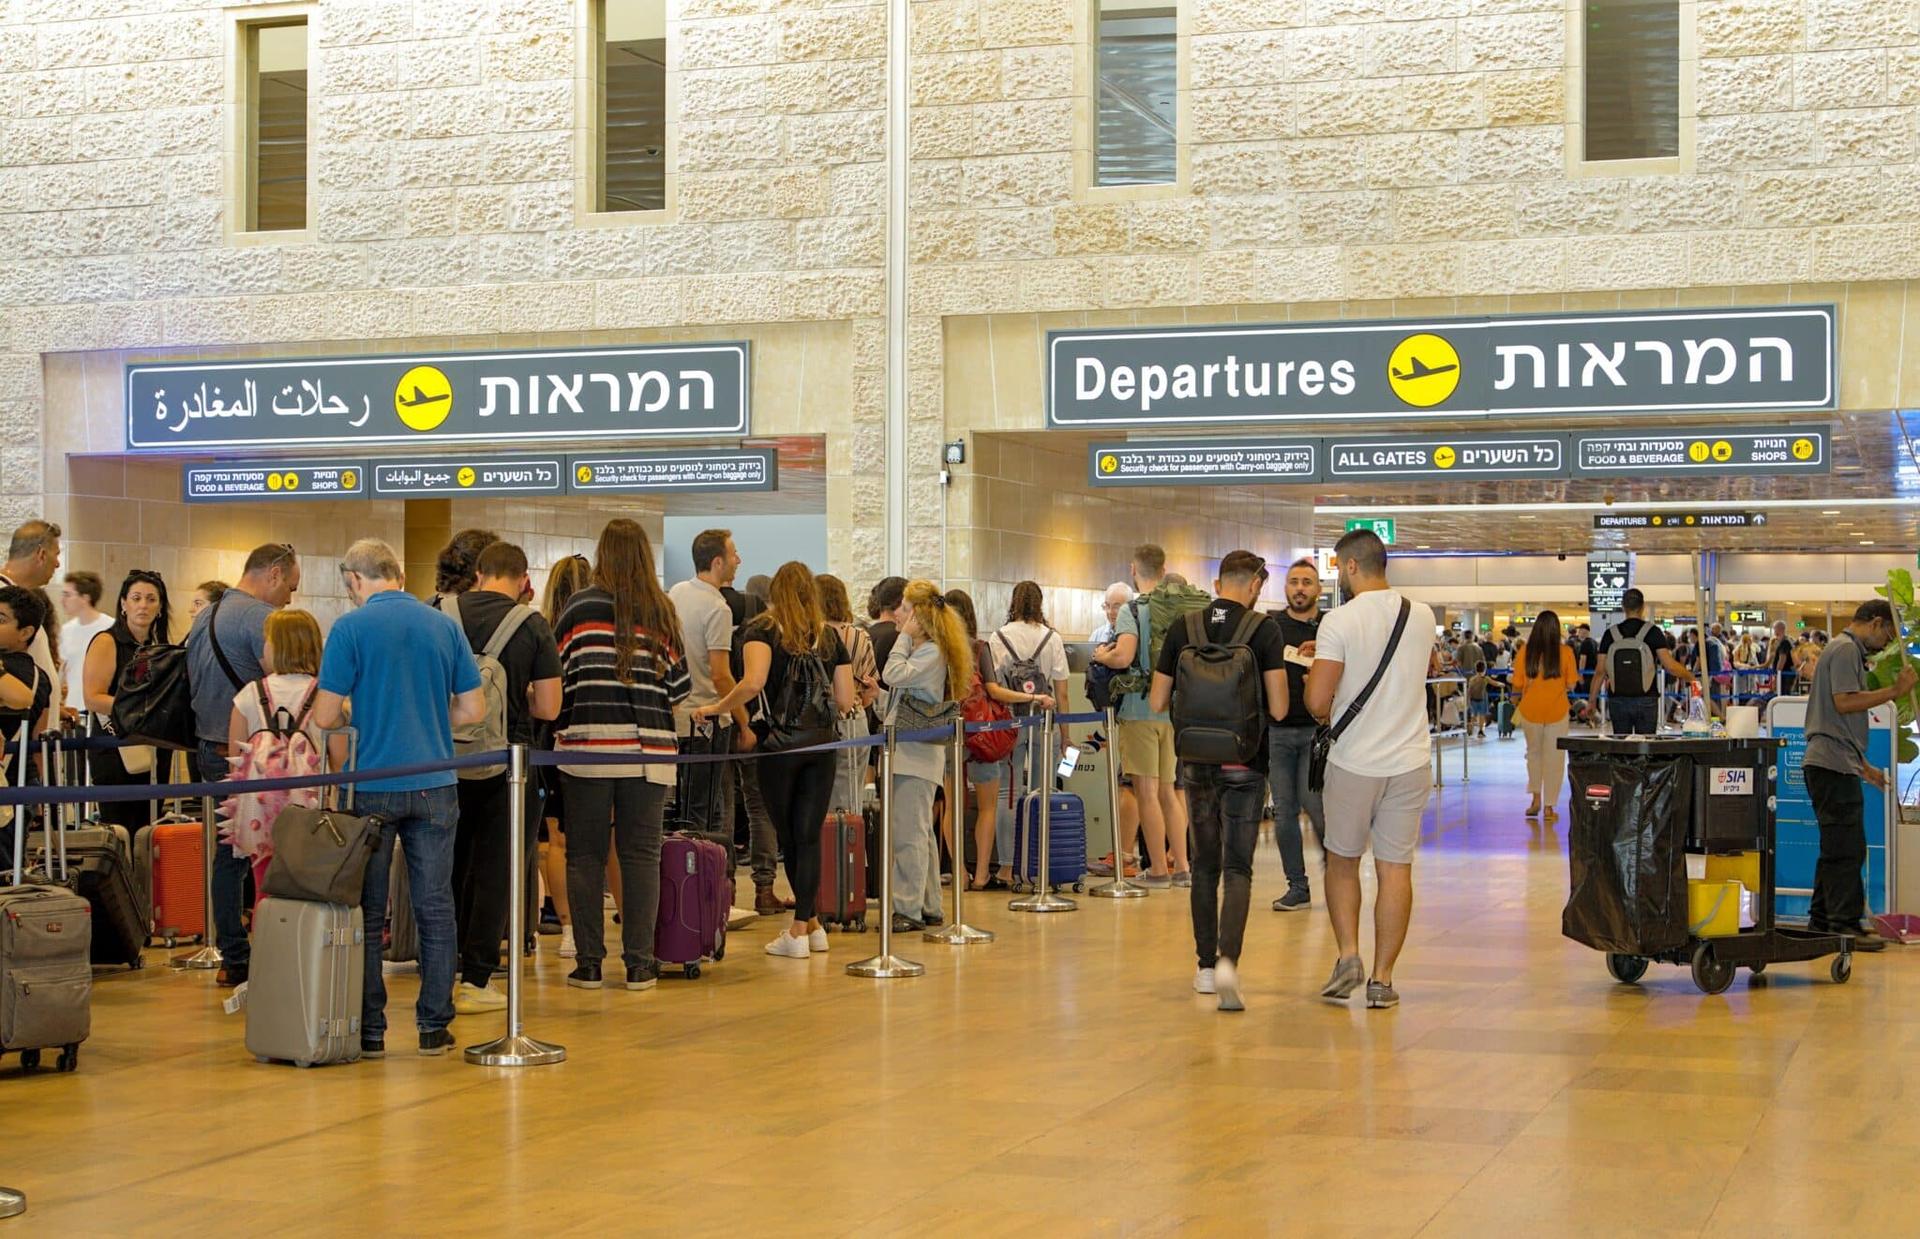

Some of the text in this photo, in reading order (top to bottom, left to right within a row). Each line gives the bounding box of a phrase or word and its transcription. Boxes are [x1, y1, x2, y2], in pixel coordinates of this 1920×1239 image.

[1495, 334, 1793, 391] המראות
[1075, 354, 1356, 411] Departures
[479, 367, 715, 417] המראות
[156, 378, 371, 433] رحلات المغادرة
[1587, 441, 1684, 453] מסעדות ובתי קפה
[1754, 439, 1787, 448] חנויות
[1120, 452, 1309, 464] בידוק ביטחוני לנוסעים עם כבודת יד בלבד
[1339, 451, 1427, 466] ALL GATES
[1463, 445, 1553, 465] כל השערים
[1589, 453, 1684, 464] FOOD & BEVERAGE
[1752, 451, 1787, 461] SHOPS
[594, 465, 615, 474] בלבד
[670, 462, 702, 472] לנוסעים
[706, 463, 736, 471] ביטחוני
[739, 462, 761, 472] בידוק
[1120, 464, 1147, 474] Security
[1149, 464, 1169, 472] check
[1180, 464, 1219, 473] passengers
[1236, 462, 1265, 471] Carry-on
[1266, 462, 1293, 471] baggage
[1294, 462, 1309, 471] only
[194, 473, 264, 482] מסעדות ובתי קפה
[313, 471, 337, 479] חנויות
[385, 470, 450, 486] جميع البوابات
[483, 468, 551, 482] כל השערים
[595, 474, 618, 484] Security
[620, 474, 637, 482] check
[647, 474, 681, 482] passengers
[683, 472, 695, 480] with
[696, 472, 722, 481] Carry-on
[723, 471, 747, 480] baggage
[748, 471, 761, 479] only
[196, 484, 216, 492] FOOD
[225, 483, 265, 491] BEVERAGE
[1601, 517, 1647, 525] DEPARTURES
[1701, 516, 1745, 524] המראות
